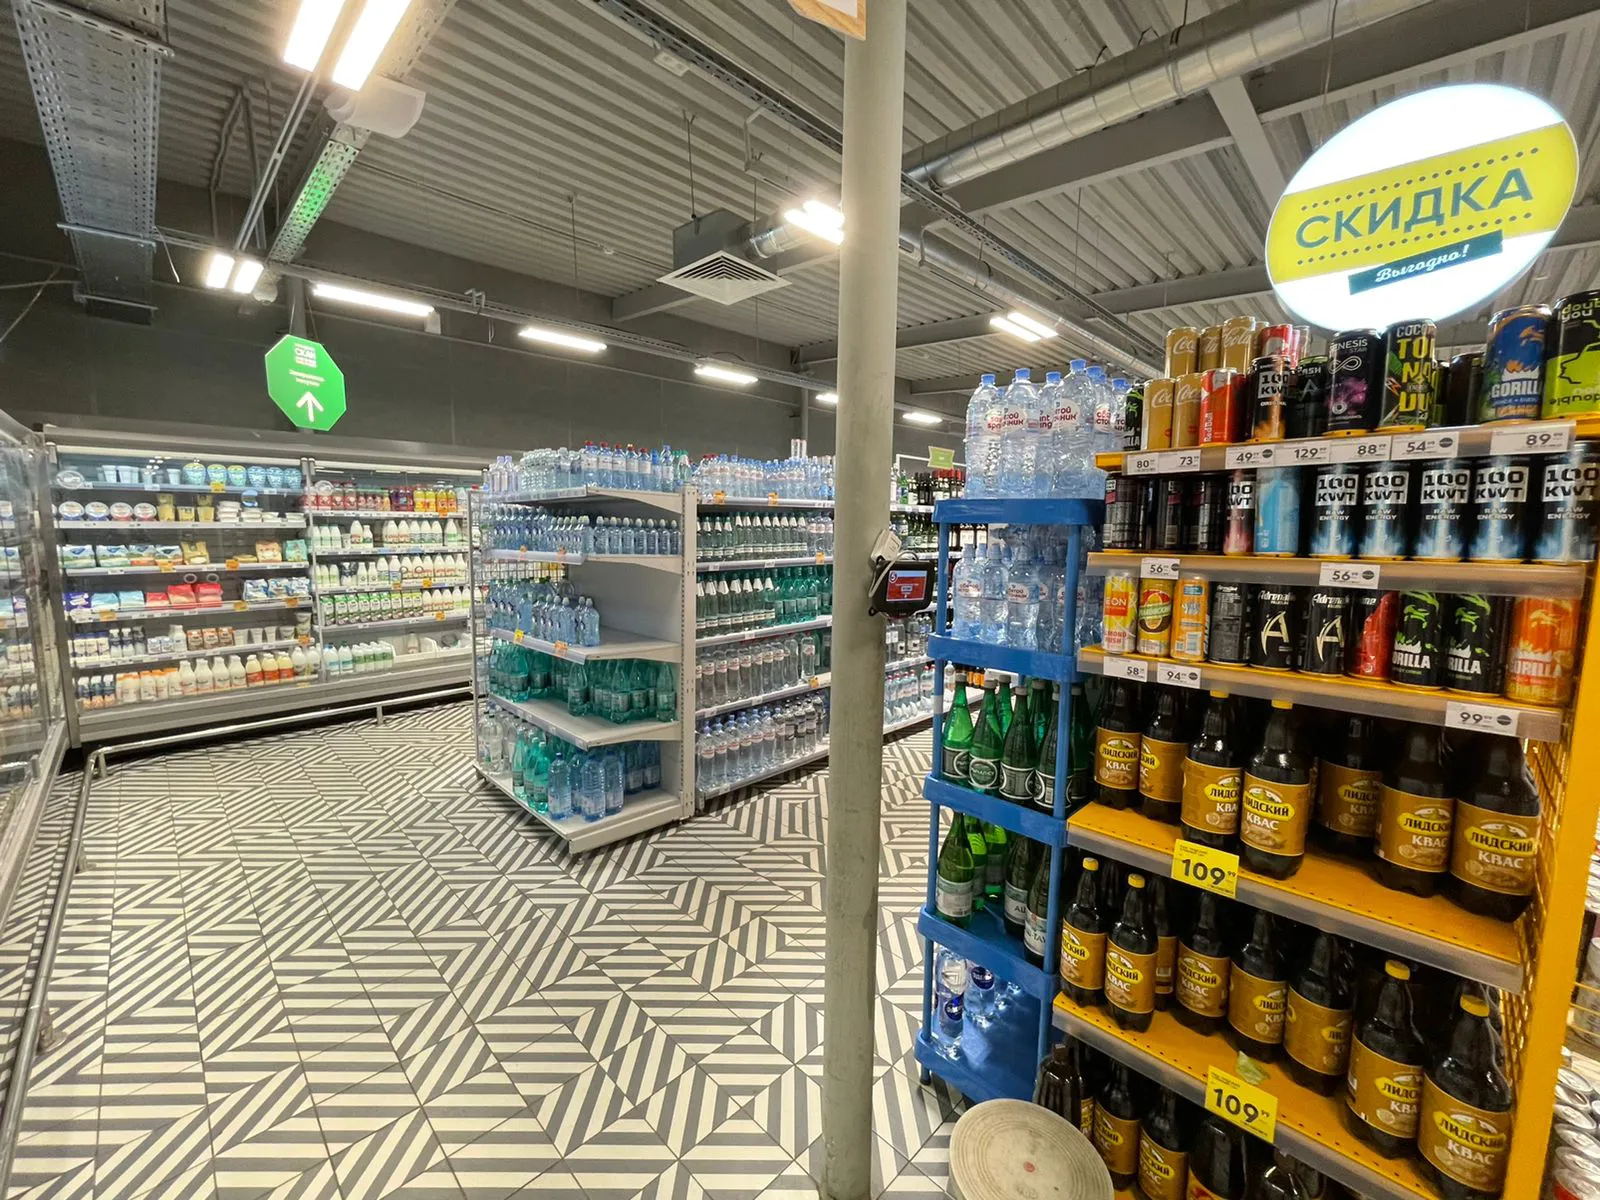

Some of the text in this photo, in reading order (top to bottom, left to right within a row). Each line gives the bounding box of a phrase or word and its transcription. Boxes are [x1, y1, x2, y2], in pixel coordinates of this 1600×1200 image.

[1295, 167, 1534, 249] СКИДКА
[1375, 243, 1471, 283] Выгодно!
[1525, 433, 1551, 445] 89
[1294, 447, 1319, 459] 129
[1357, 444, 1377, 455] 88
[1405, 441, 1427, 453] 54
[1179, 456, 1193, 466] 73
[1236, 452, 1254, 462] 49
[1136, 460, 1150, 469] 80
[1424, 473, 1468, 486] 100
[1476, 470, 1525, 485] 100
[1546, 467, 1600, 482] 100
[1318, 477, 1356, 489] 100
[1365, 475, 1406, 489] 100
[1318, 492, 1355, 502] KWT
[1365, 490, 1404, 501] KWT
[1423, 489, 1467, 500] KWT
[1475, 487, 1523, 500] KWT
[1545, 485, 1598, 498] KWT
[1149, 564, 1163, 573] 56
[1331, 570, 1350, 580] 56
[1126, 666, 1140, 676] 58
[1166, 671, 1182, 681] 94
[1460, 711, 1484, 724] 99
[1105, 760, 1132, 771] КВАС
[1246, 811, 1280, 831] КВАС
[1471, 831, 1534, 853] ЛИДСКИЙ
[1478, 849, 1525, 870] КВАС
[1182, 858, 1226, 886] 109
[1181, 977, 1209, 997] КВАС
[1213, 1088, 1259, 1123] 109
[1447, 1139, 1495, 1165] КВАС
